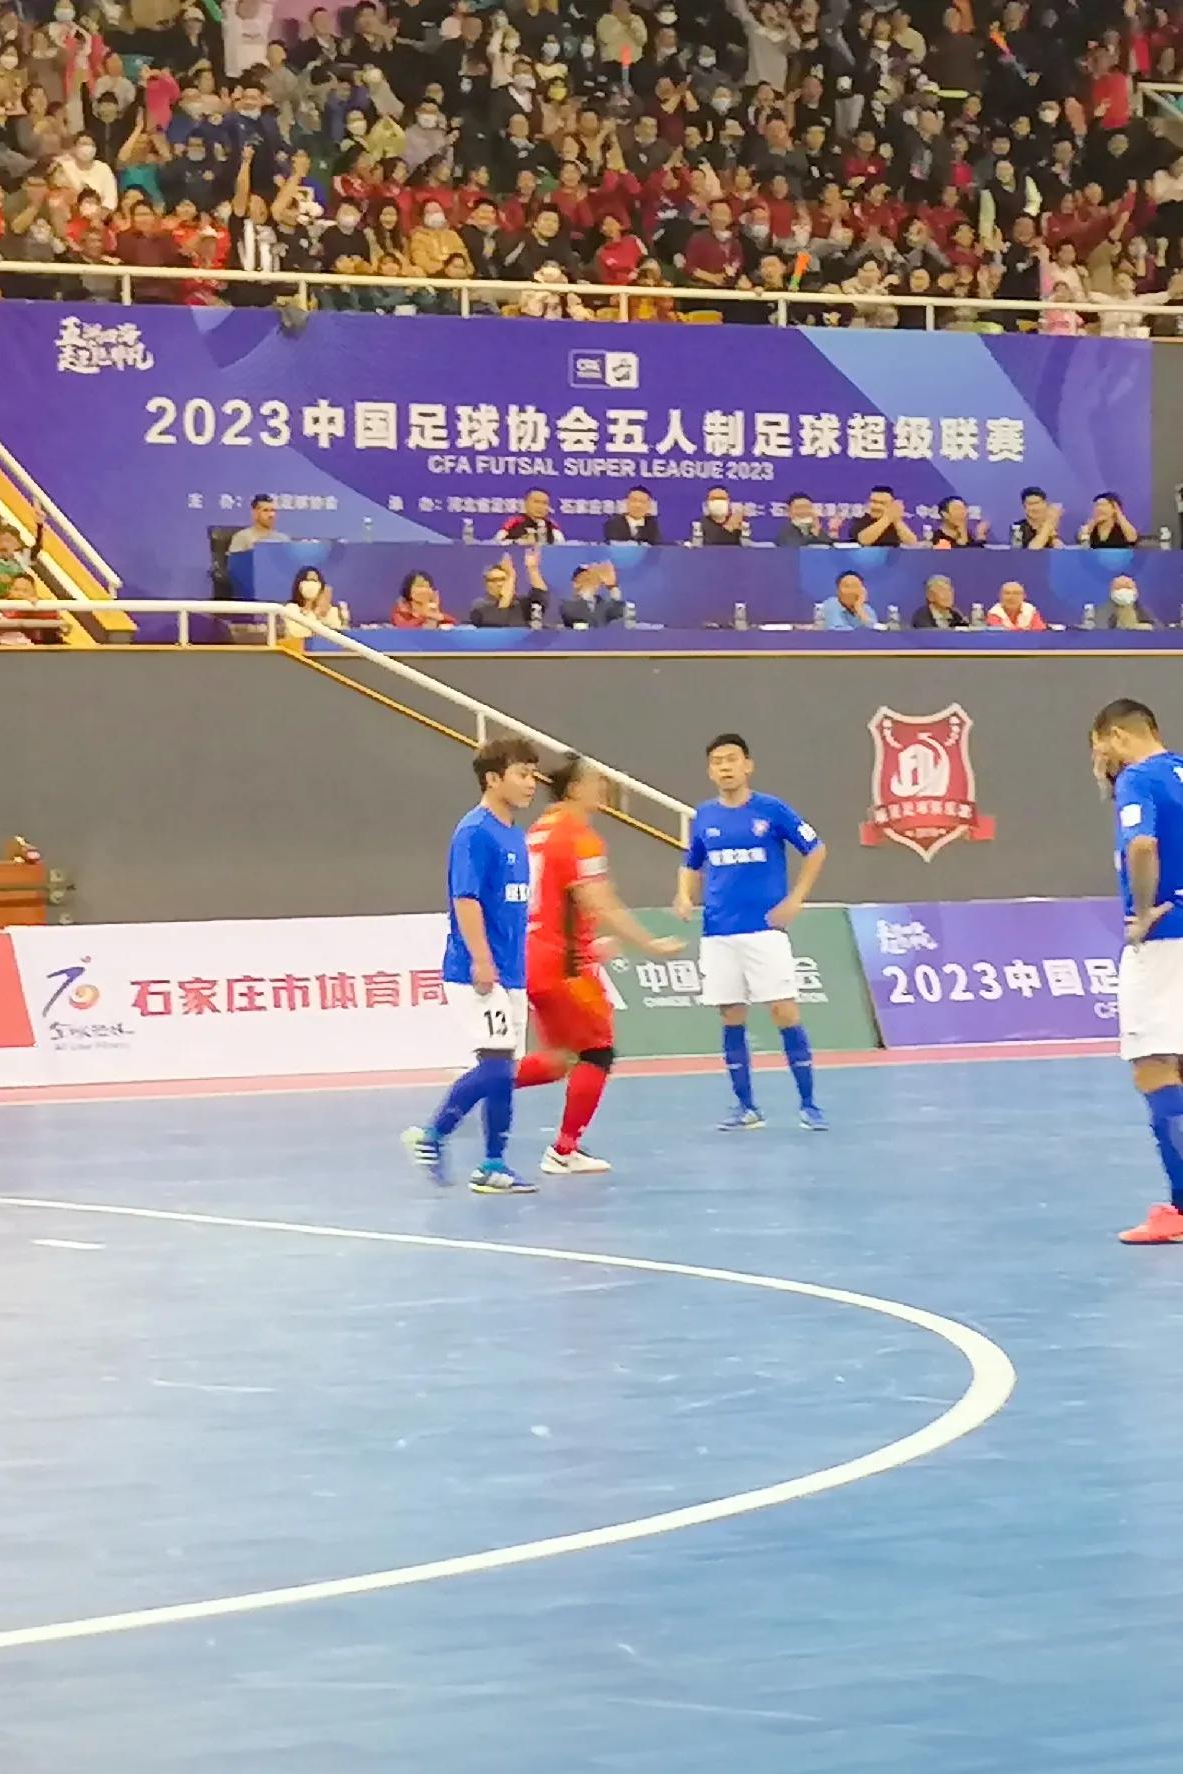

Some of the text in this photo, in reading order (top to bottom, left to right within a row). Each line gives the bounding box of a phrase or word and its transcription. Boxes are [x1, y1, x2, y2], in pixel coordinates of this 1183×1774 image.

[145, 397, 1025, 463] 2023中国足球协会五人制足球超级联赛
[428, 455, 774, 481] CFA FUTSAL SUPER LEAGUE 2023
[130, 969, 449, 1017] 石家庄市体育局
